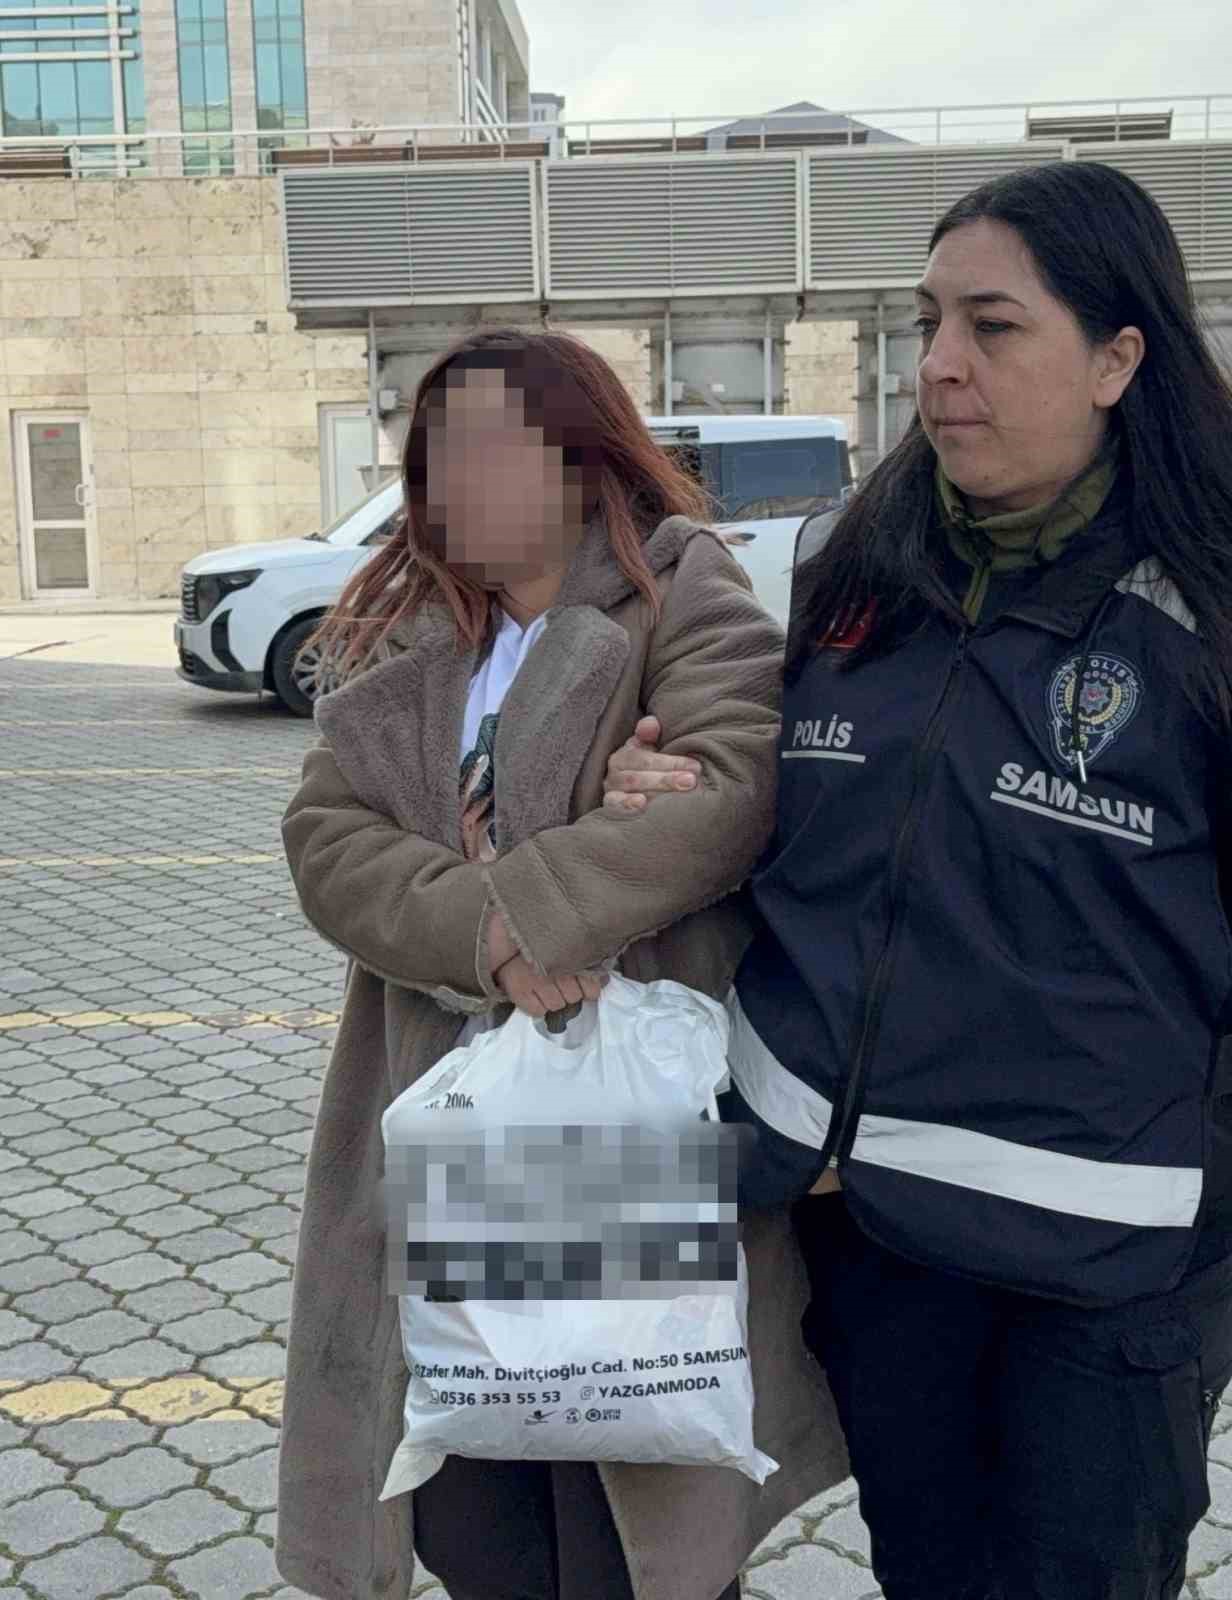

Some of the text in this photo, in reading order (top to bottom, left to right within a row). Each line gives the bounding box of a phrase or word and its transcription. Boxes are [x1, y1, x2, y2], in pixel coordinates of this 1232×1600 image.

[792, 713, 854, 749] POLİS
[996, 761, 1155, 834] SAMSUN
[452, 1364, 489, 1380] Mah.
[494, 1362, 587, 1383] Divitçioğlu
[591, 1359, 627, 1374] Cad.
[632, 1354, 678, 1371] No:50
[683, 1346, 747, 1365] SAMSUN
[440, 1390, 561, 1405] 0536 353 55 53
[598, 1375, 721, 1399] YAZGANMODA
